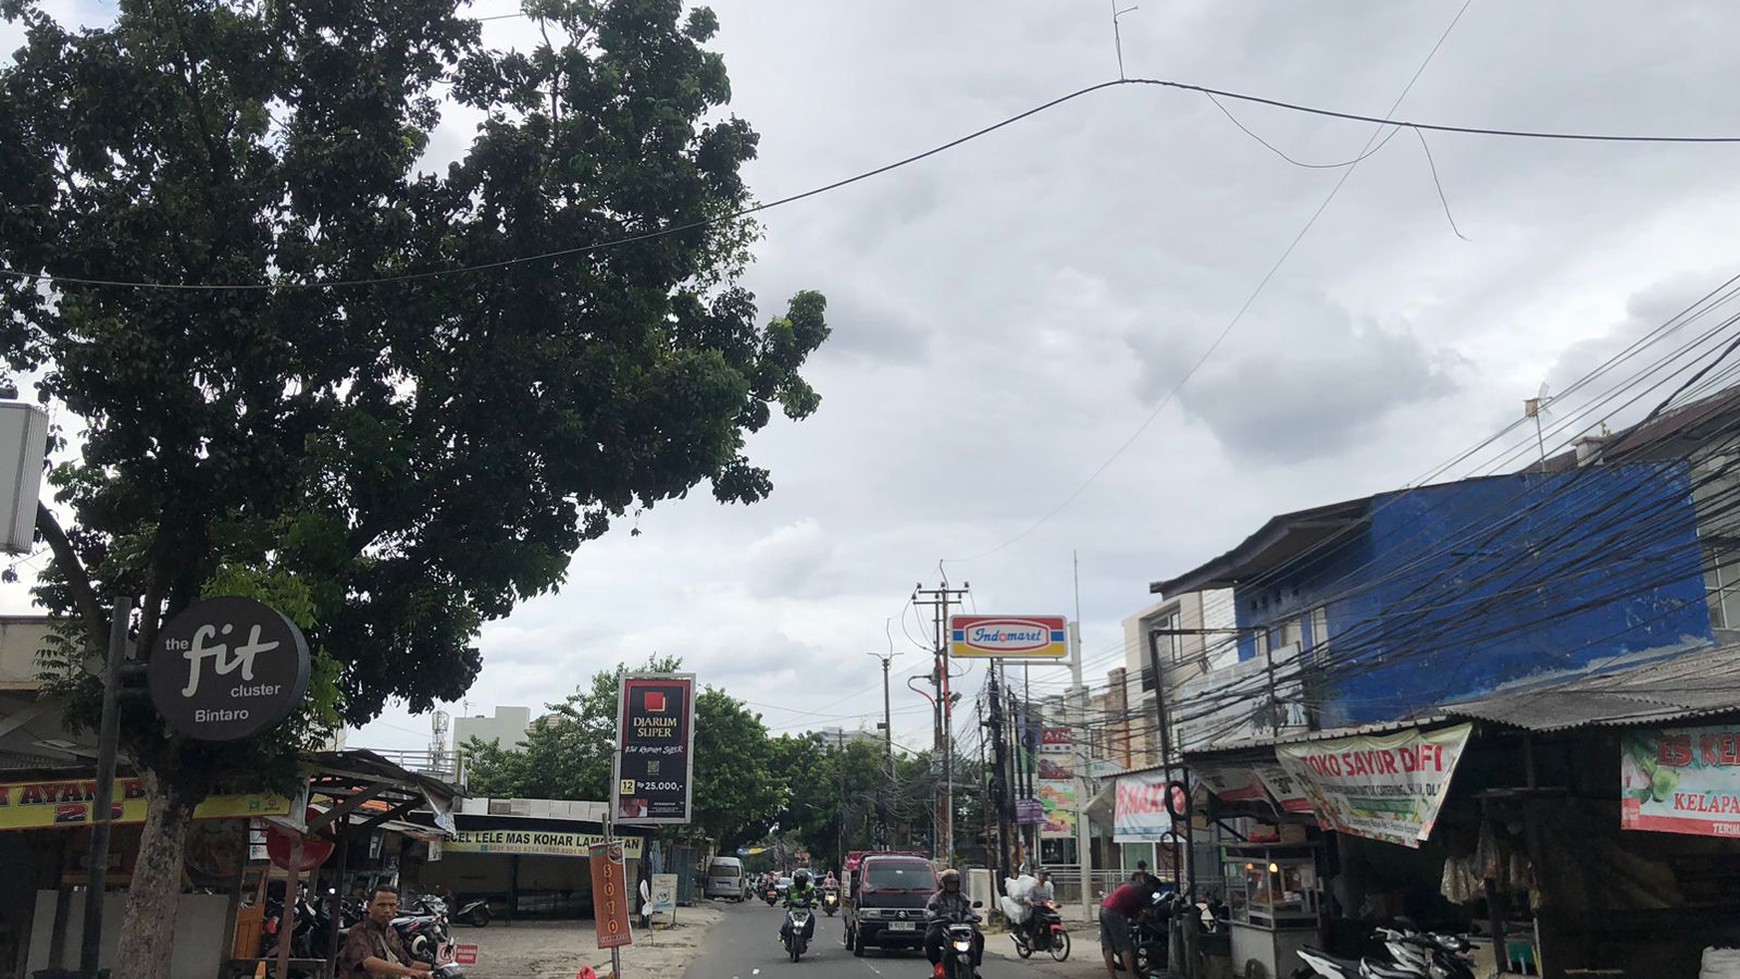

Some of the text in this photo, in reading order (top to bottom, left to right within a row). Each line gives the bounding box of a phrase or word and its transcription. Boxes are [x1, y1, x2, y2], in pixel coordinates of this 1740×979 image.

[972, 627, 1042, 642] Indomaret
[165, 623, 279, 698] the fit
[230, 684, 281, 698] cluster
[195, 708, 249, 723] Bintaro
[633, 717, 677, 727] DJARUM
[637, 728, 672, 738] SUPER
[1656, 734, 1693, 767] ES
[1300, 754, 1342, 777] TOKO
[1342, 750, 1398, 776] SAYUR
[623, 781, 633, 790] 12
[645, 781, 683, 791] 25.000,-
[1673, 793, 1740, 813] KELAPA
[443, 831, 639, 849] ECEL LELE MAS KOHAR LAMAN
[603, 863, 618, 934] SOTO
